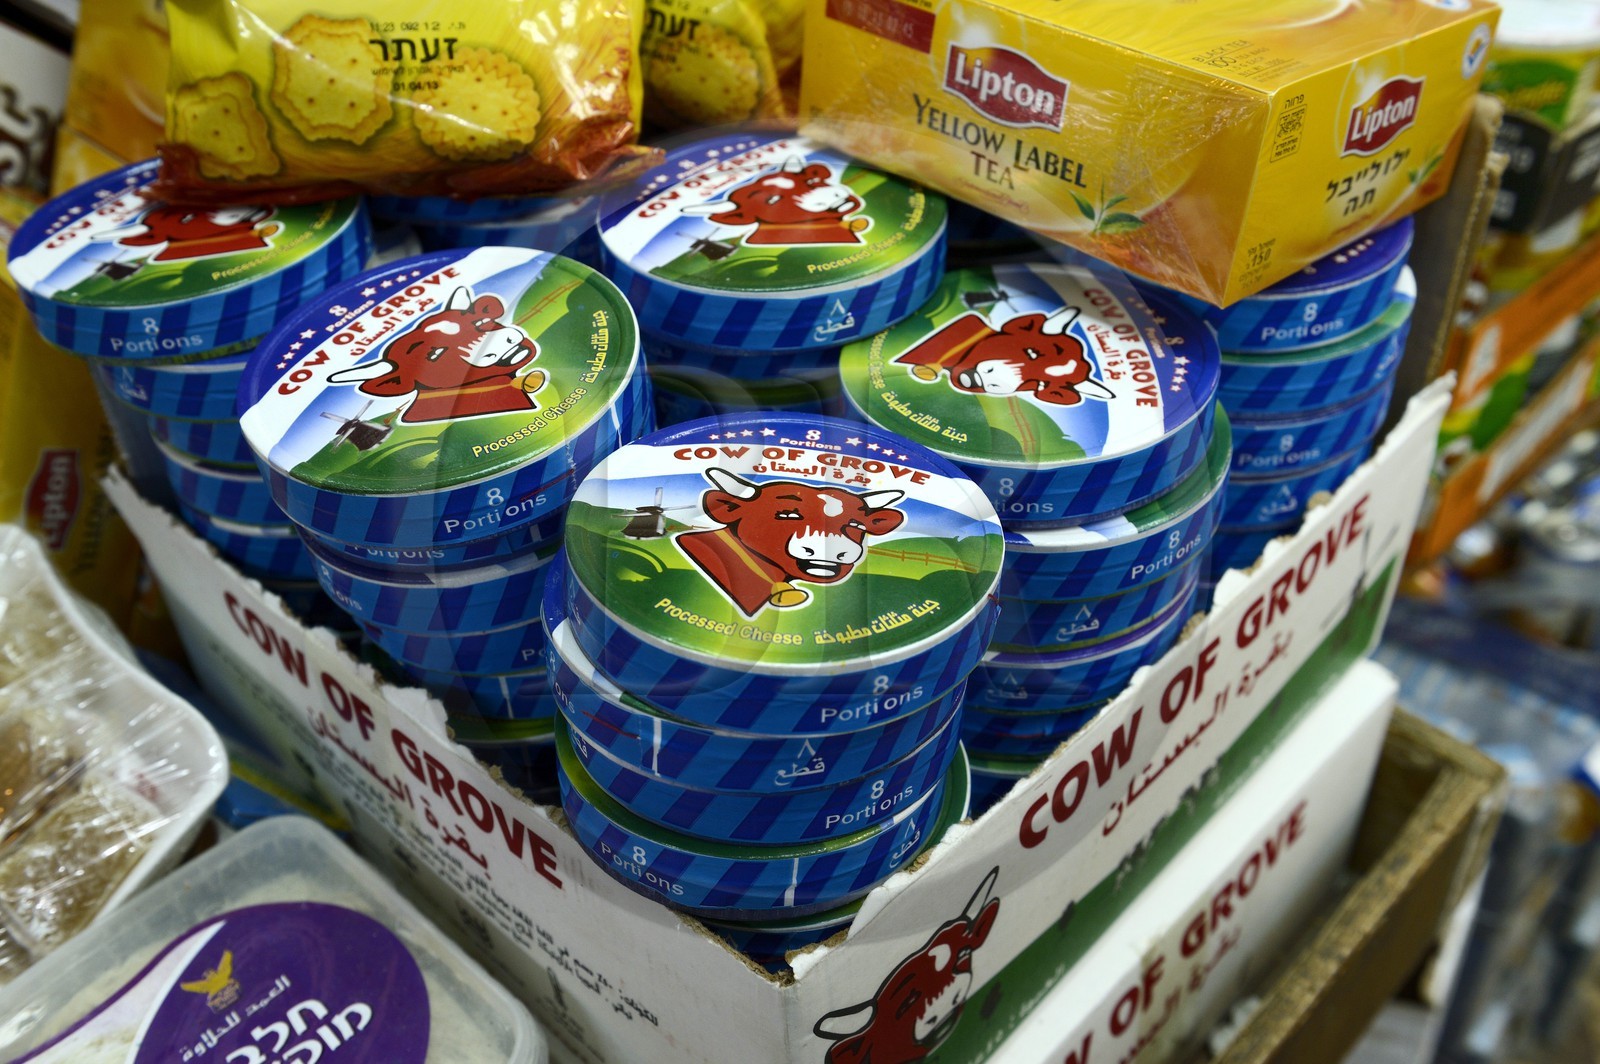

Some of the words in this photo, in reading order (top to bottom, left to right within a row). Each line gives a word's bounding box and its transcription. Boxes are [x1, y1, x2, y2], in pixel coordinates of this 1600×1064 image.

[369, 37, 458, 63] זעתר
[953, 52, 1056, 117] Lipton
[1351, 93, 1416, 141] Lipton
[912, 93, 1008, 155] YELLOW
[1014, 138, 1087, 189] LABEL
[971, 150, 1015, 191] TEA
[1344, 187, 1377, 217] תה
[806, 250, 871, 274] Processed
[325, 299, 376, 333] Portions
[328, 304, 349, 317] 8
[1083, 288, 1125, 320] COW
[1303, 301, 1318, 323] 8
[142, 317, 160, 335] 8
[277, 349, 331, 396] COW
[332, 321, 366, 346] OF
[371, 267, 461, 318] GROVE
[350, 315, 403, 357] البستان
[812, 311, 856, 343] قطع
[1113, 323, 1141, 343] OF
[1261, 316, 1345, 341] Portions
[110, 334, 203, 354] Portions
[1126, 348, 1159, 408] GROVE
[472, 417, 548, 458] Processed
[542, 386, 588, 421] Cheese
[806, 428, 821, 441] 8
[779, 436, 843, 452] Portions
[673, 446, 751, 461] COW
[762, 446, 806, 461] OF
[816, 452, 932, 486] GROVE
[752, 461, 827, 478] البستان
[832, 468, 872, 487] بقرة
[486, 486, 505, 509] 8
[999, 477, 1016, 497] 8
[443, 492, 547, 534] Portions
[994, 499, 1054, 514] tions
[1168, 529, 1181, 549] 8
[1131, 533, 1202, 580] Portions
[654, 598, 738, 636] Processed
[739, 625, 804, 646] Cheese
[1074, 604, 1093, 621] ٨
[814, 623, 874, 647] مطبوخة
[1055, 617, 1101, 643] قطع
[1019, 706, 1143, 851] COW
[1159, 636, 1221, 726] OF
[1236, 491, 1371, 651] GROVE
[873, 674, 890, 697] 8
[820, 684, 925, 724] Portions
[224, 590, 310, 688] COW
[321, 672, 376, 742] OF
[391, 728, 564, 891] GROVE
[797, 737, 817, 758] ٨
[774, 756, 827, 787] قطع
[870, 778, 886, 801] 8
[825, 784, 914, 830] Portions
[600, 841, 685, 897] Portions
[633, 845, 648, 868] 8
[1108, 955, 1165, 1039] OF
[1180, 800, 1309, 960] GROVE
